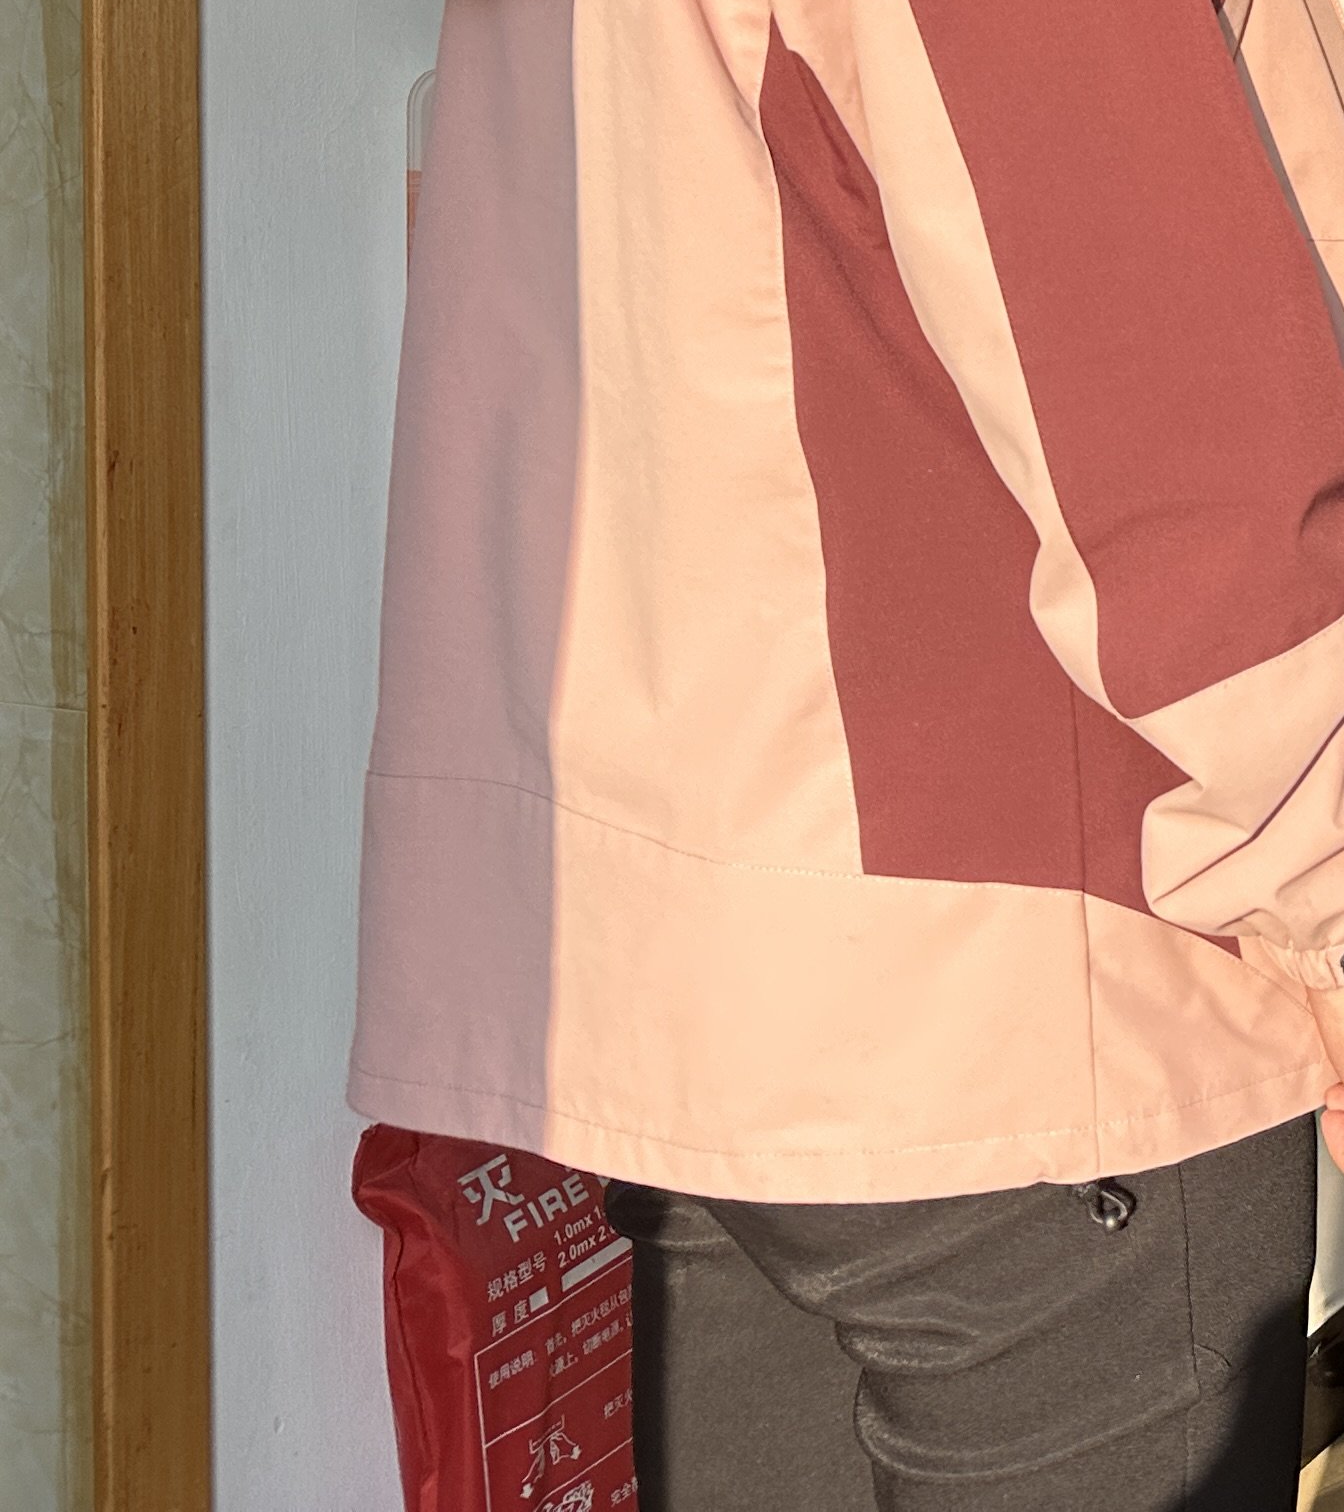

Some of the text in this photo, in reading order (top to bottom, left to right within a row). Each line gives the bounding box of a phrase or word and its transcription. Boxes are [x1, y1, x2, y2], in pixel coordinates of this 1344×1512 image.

[456, 1152, 526, 1227] 灭
[502, 1173, 591, 1244] FIRE
[487, 1251, 548, 1303] 规格型号
[544, 1284, 632, 1356] 首先，把灭火毯从包
